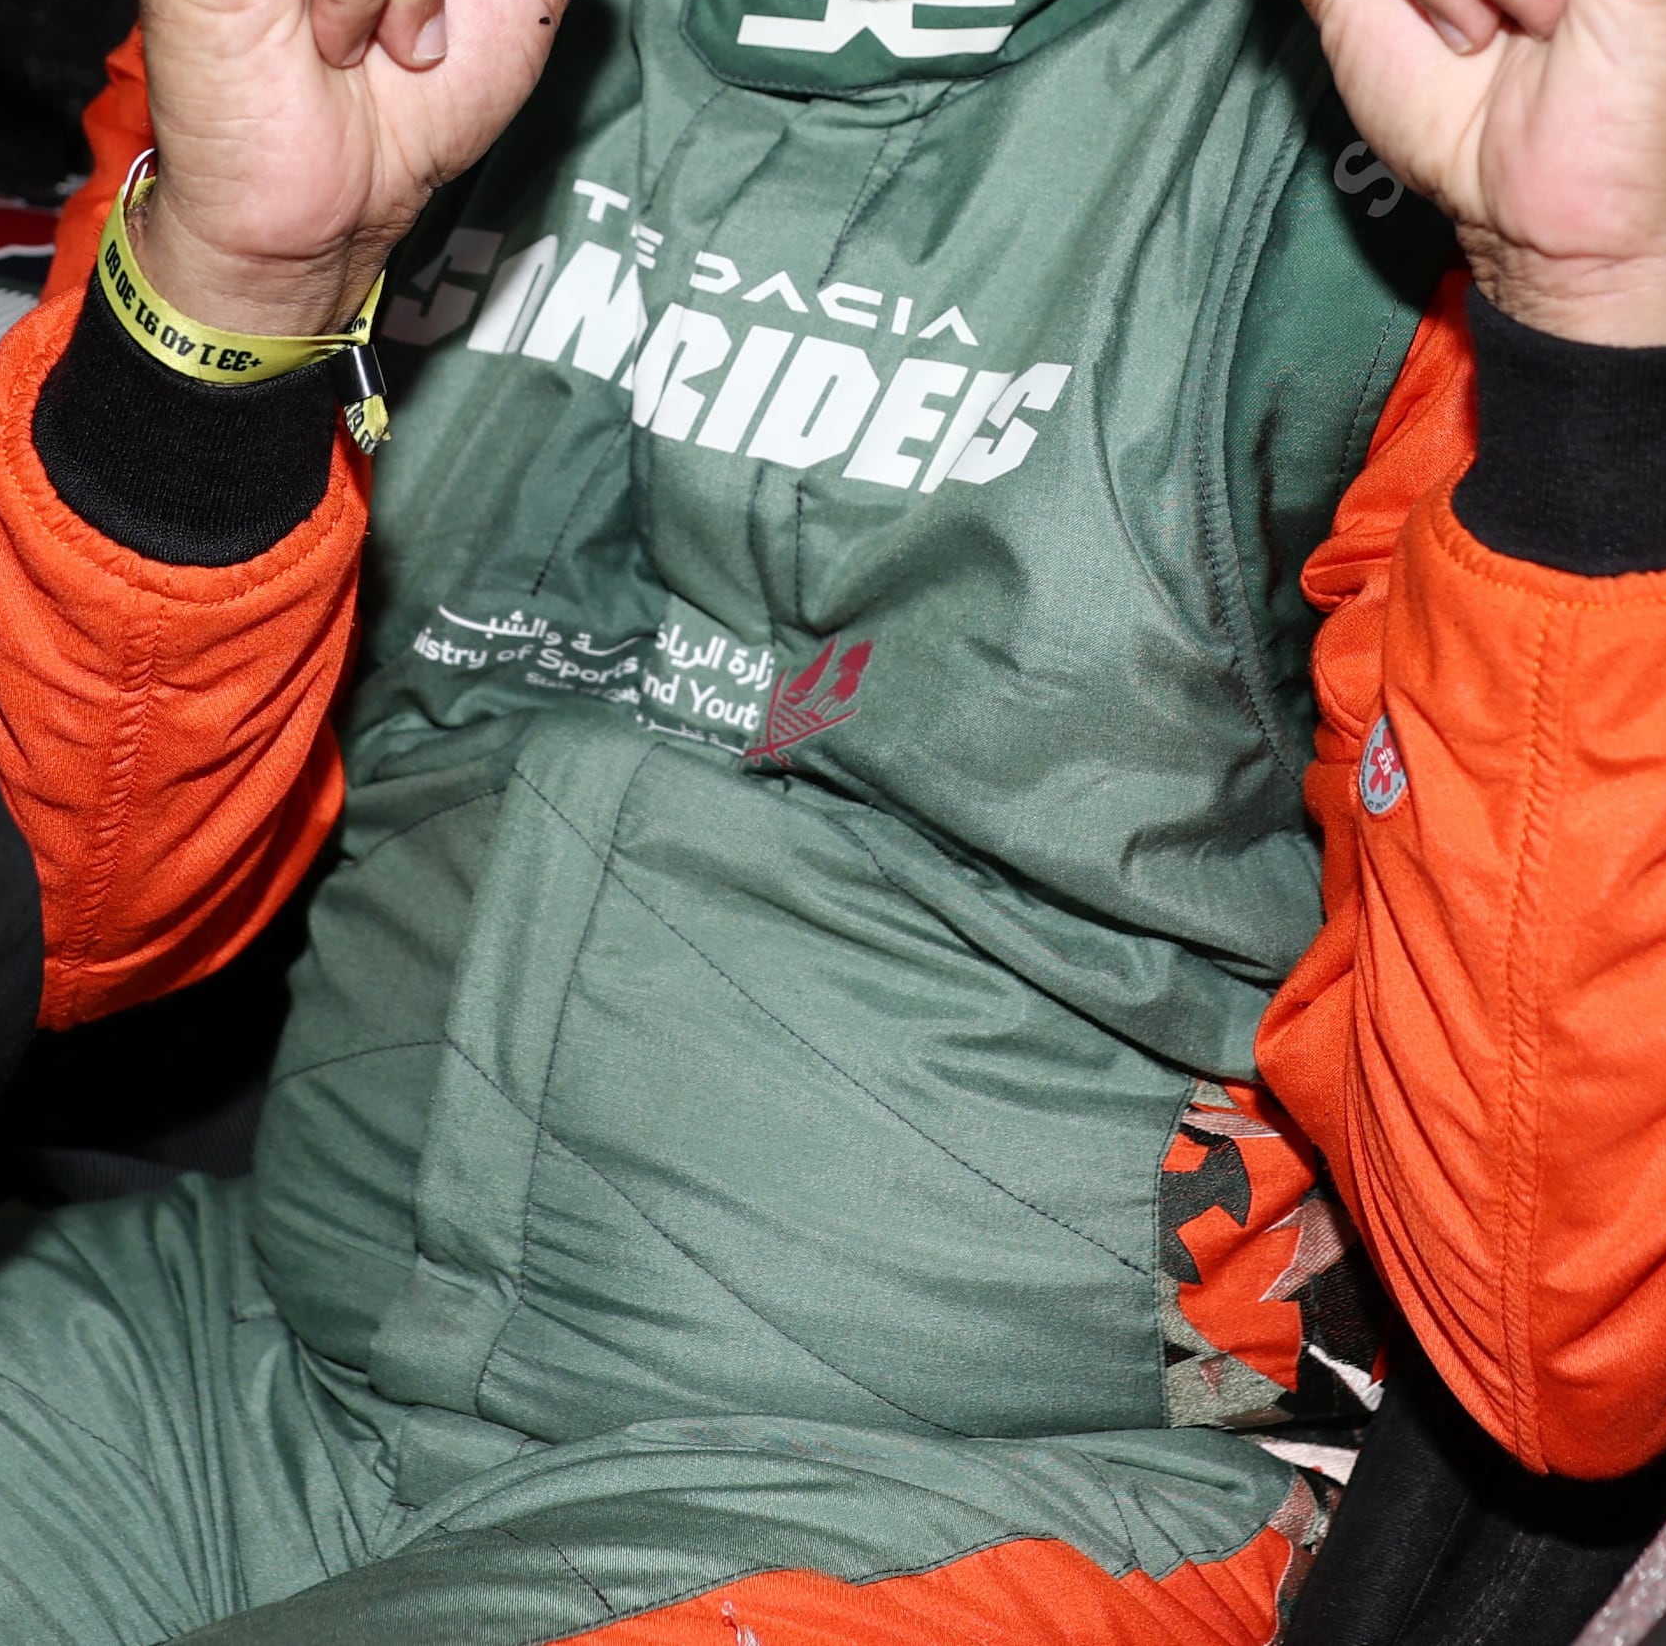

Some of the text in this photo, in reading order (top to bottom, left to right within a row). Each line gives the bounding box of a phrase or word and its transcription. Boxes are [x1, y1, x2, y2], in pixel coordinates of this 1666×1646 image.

[104, 239, 264, 371] +33 1 40 91 30 60
[689, 250, 980, 346] DACIA
[380, 228, 1073, 493] SANRIDES
[496, 643, 535, 662] of
[642, 667, 680, 705] nd
[689, 679, 760, 732] Yout
